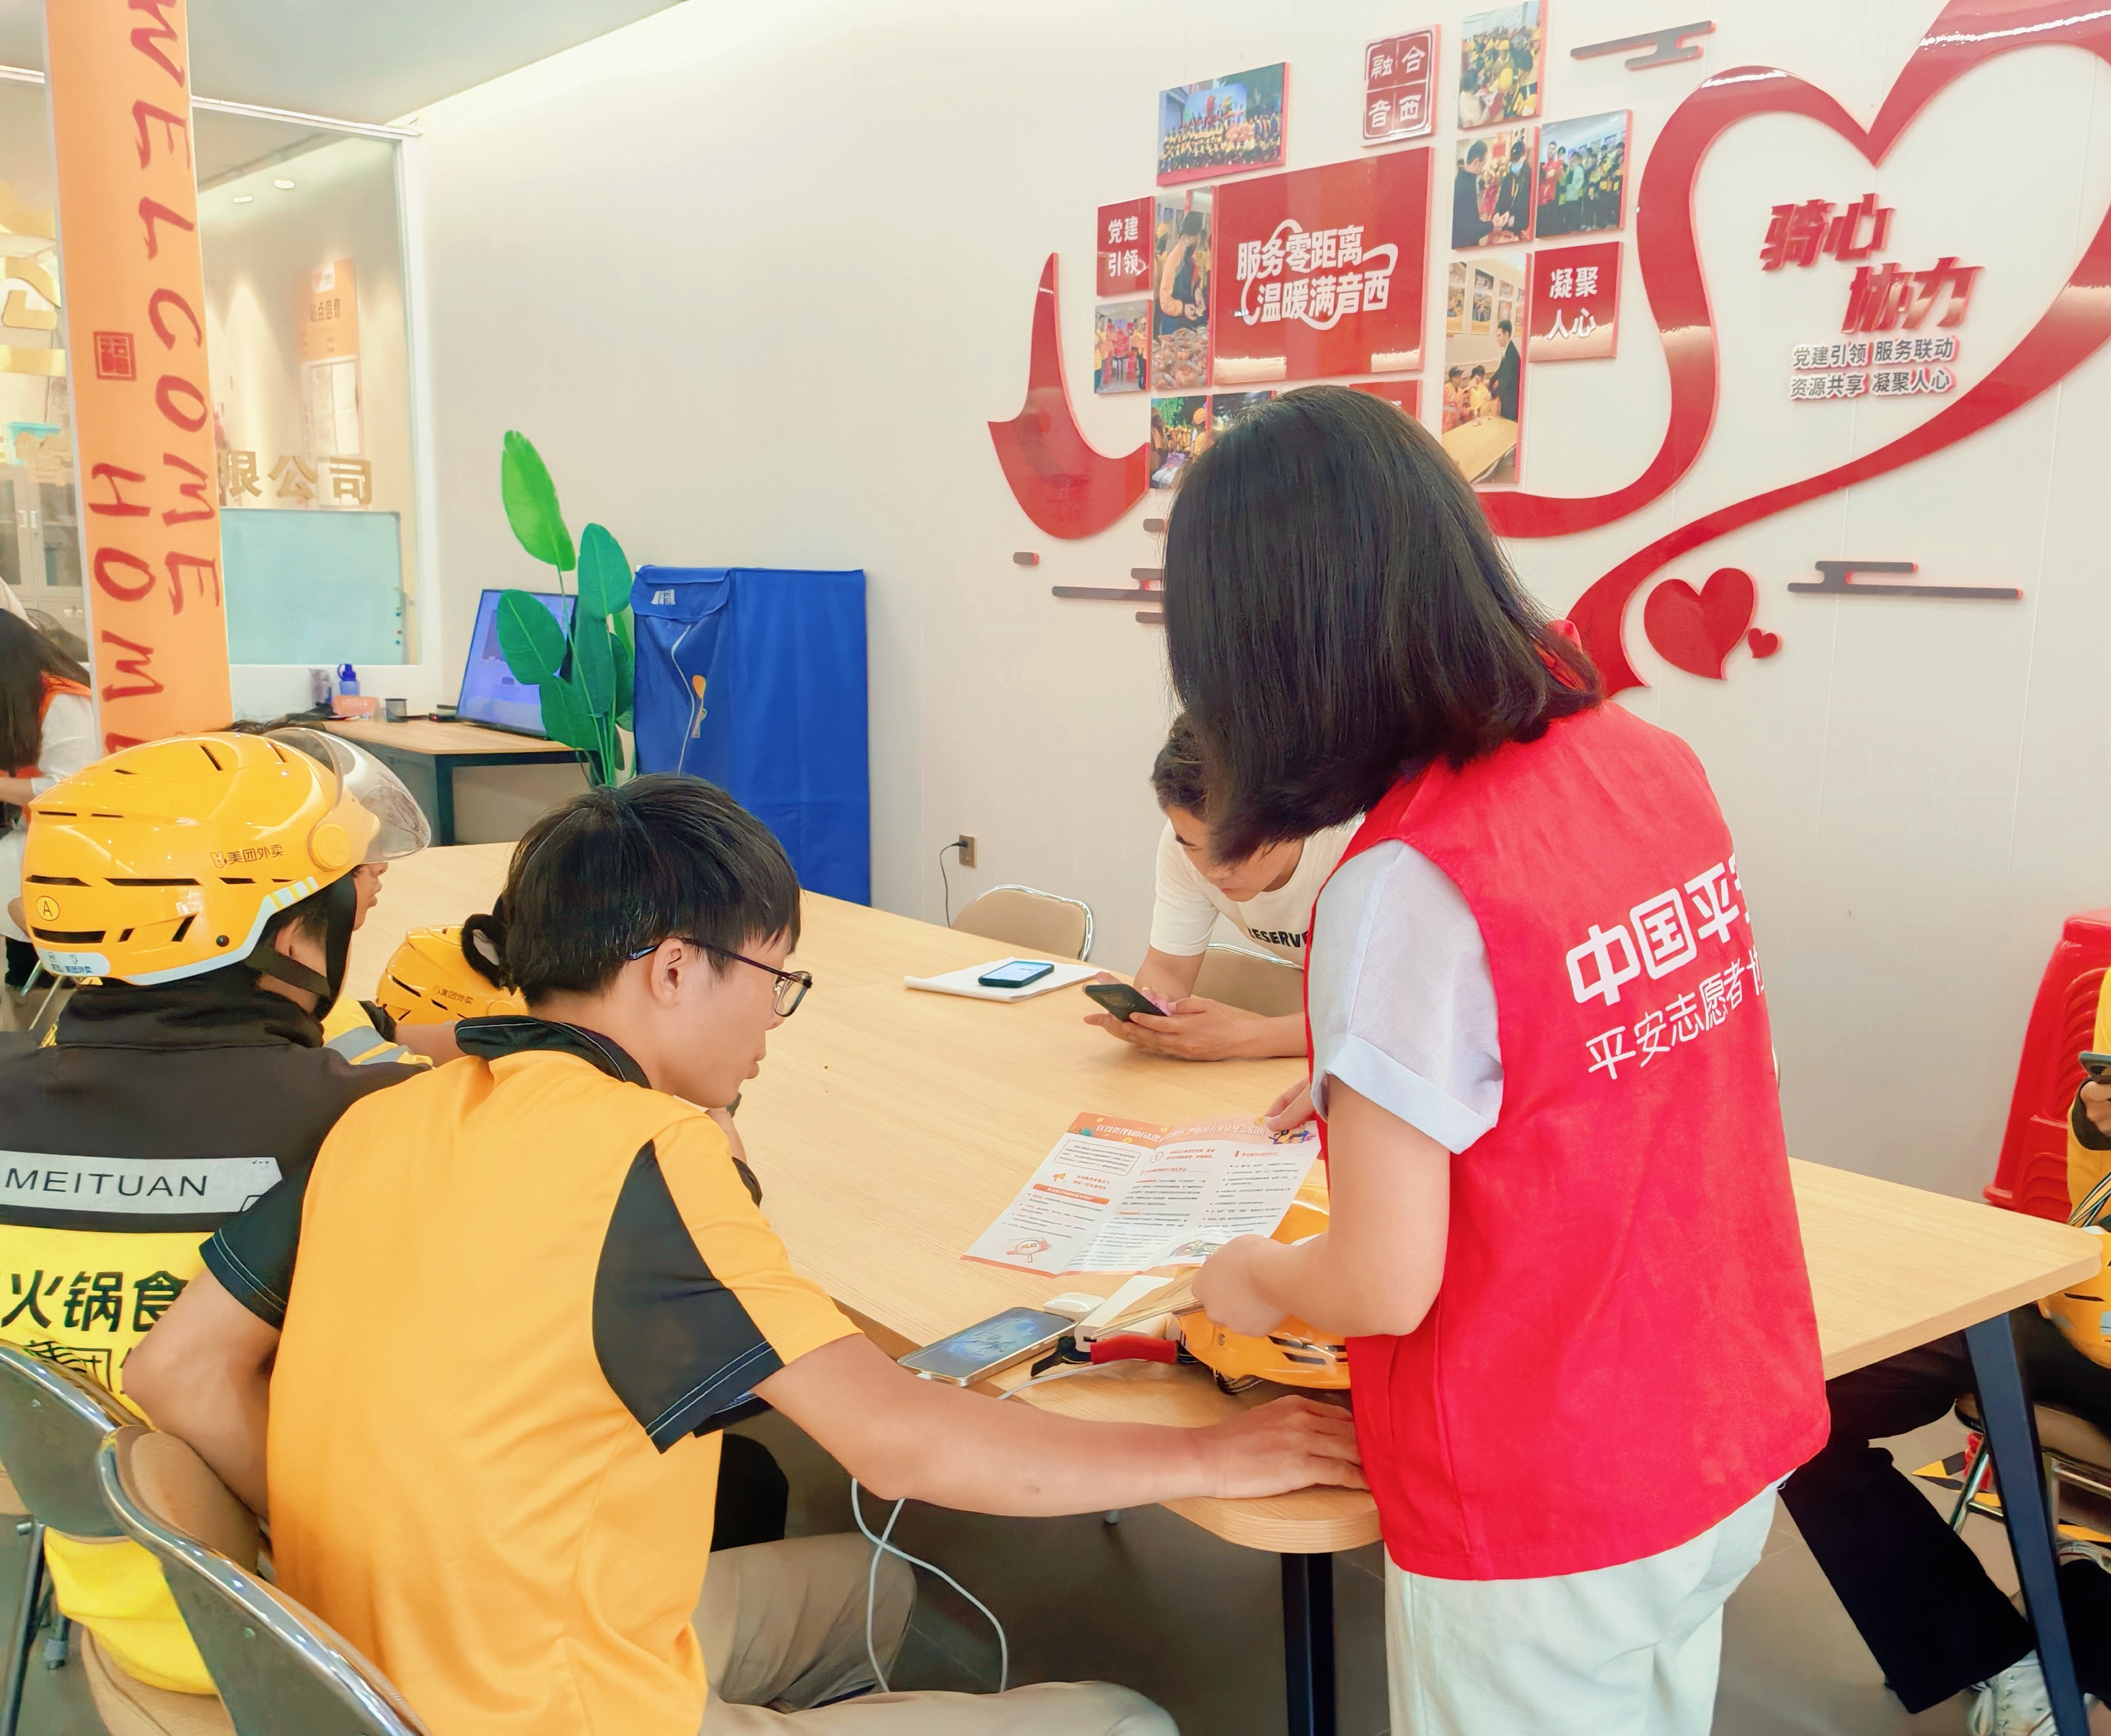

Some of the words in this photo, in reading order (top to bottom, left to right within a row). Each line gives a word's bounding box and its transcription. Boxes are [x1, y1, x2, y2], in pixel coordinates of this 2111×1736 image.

[1371, 45, 1426, 78] 融合
[1369, 93, 1422, 127] 音西
[1108, 215, 1139, 245] 党建
[1759, 193, 1895, 271] 骑心
[1108, 251, 1139, 278] 引领
[1237, 224, 1364, 280] 服务零距离
[1257, 269, 1390, 324] 温暖满音西
[1549, 267, 1599, 299] 凝聚
[1841, 256, 1985, 334] 协力
[1546, 309, 1596, 340] 人心
[1793, 343, 1867, 368] 党建引领
[1875, 337, 1953, 362] 服务联动
[1791, 373, 1864, 398] 资源共享
[1873, 370, 1950, 393] 凝聚人心
[228, 844, 283, 865] 美团外卖
[43, 900, 53, 917] A
[4, 1167, 207, 1197] MEITUAN
